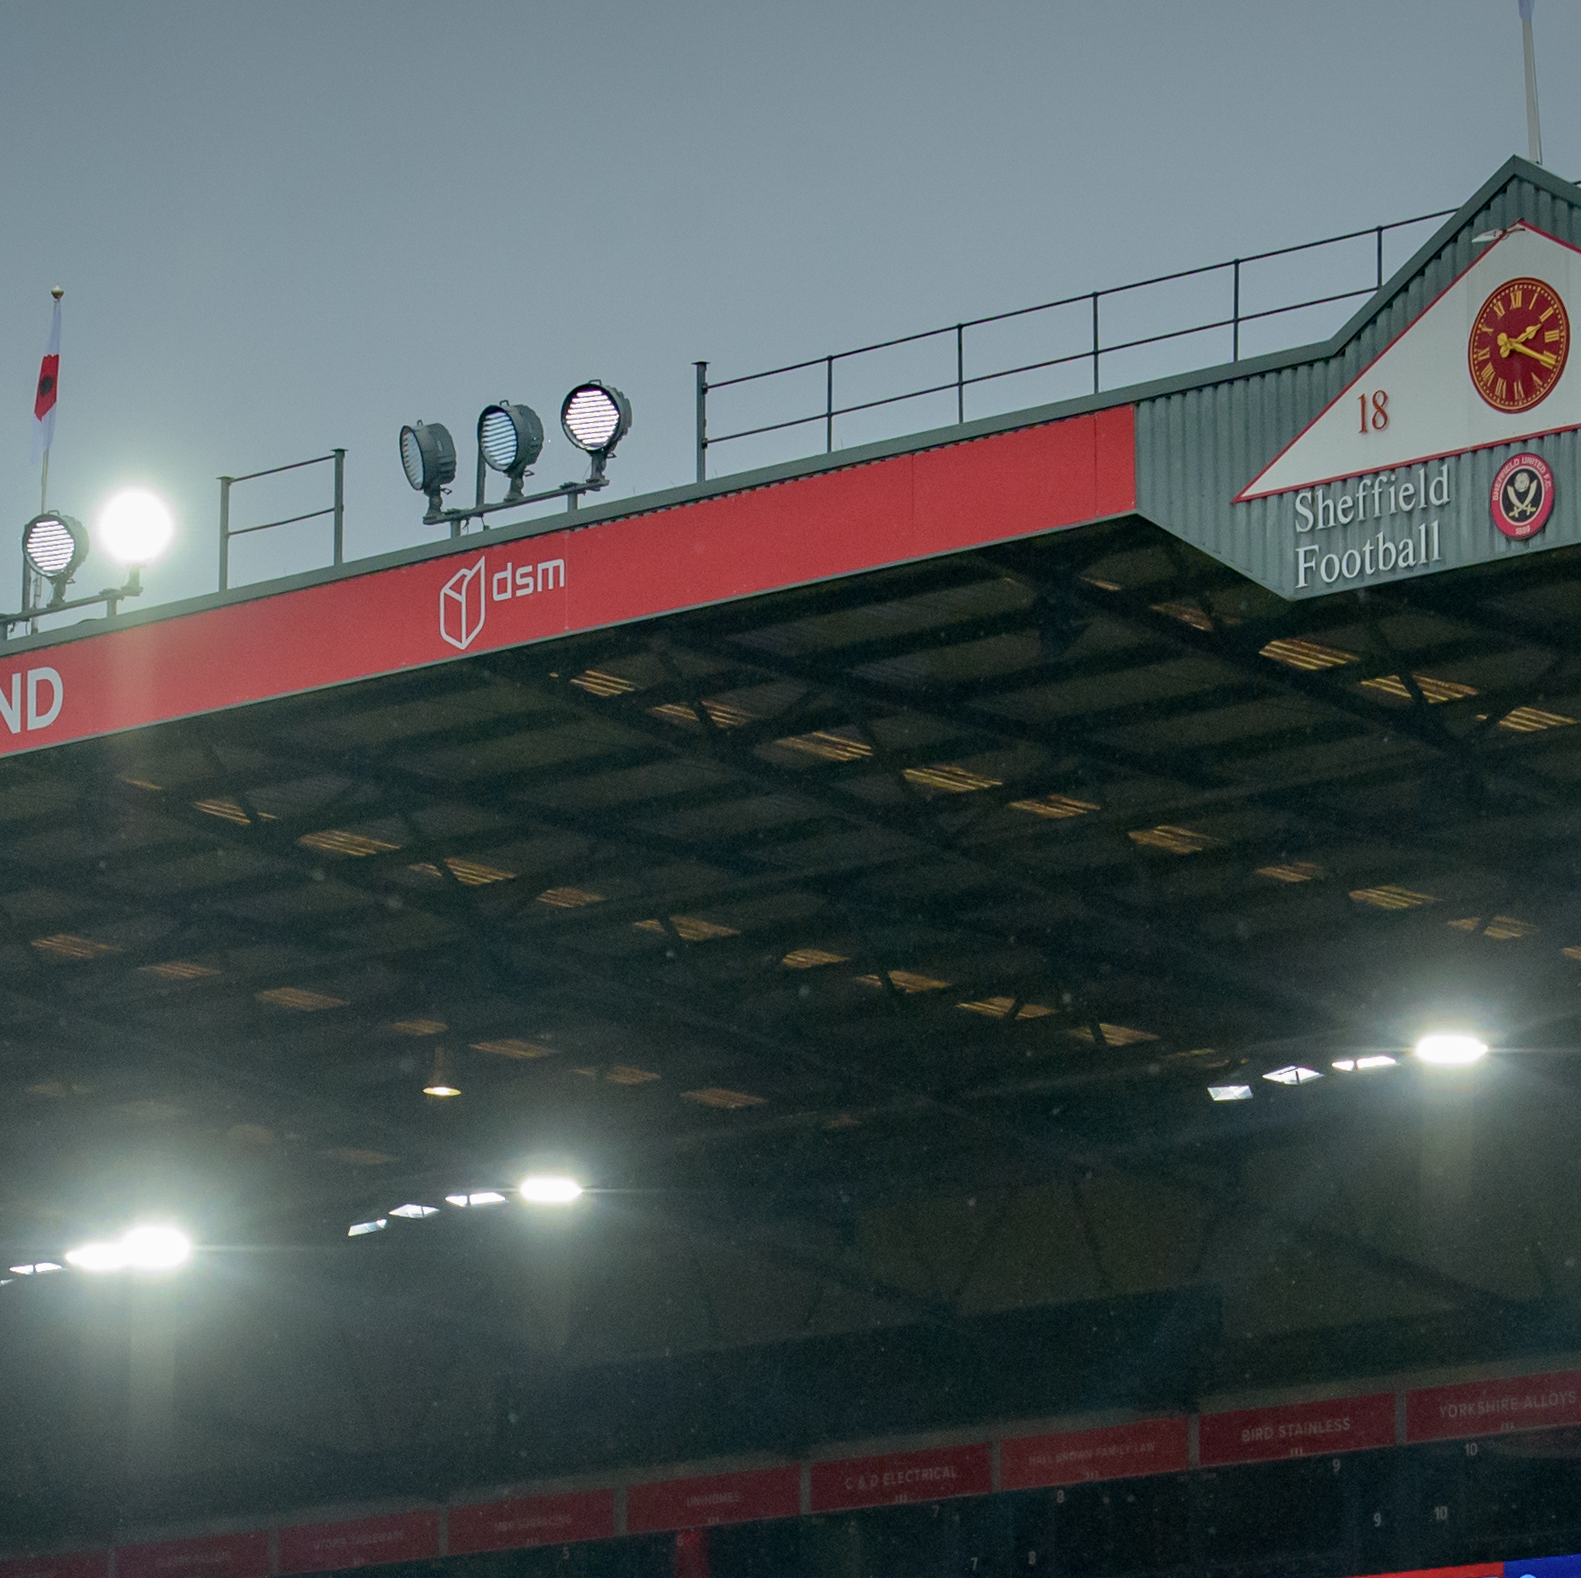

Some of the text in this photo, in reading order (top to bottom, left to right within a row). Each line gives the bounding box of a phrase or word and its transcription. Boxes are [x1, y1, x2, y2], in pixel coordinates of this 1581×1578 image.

[1357, 389, 1390, 434] 18
[1295, 464, 1451, 533] Sheffield
[1295, 520, 1442, 589] Football
[492, 558, 565, 601] dsm
[1439, 1396, 1518, 1419] YORKSHIRE
[1241, 1416, 1350, 1443] BIRD STAINLESS
[882, 1465, 957, 1488] ELECTRICAL
